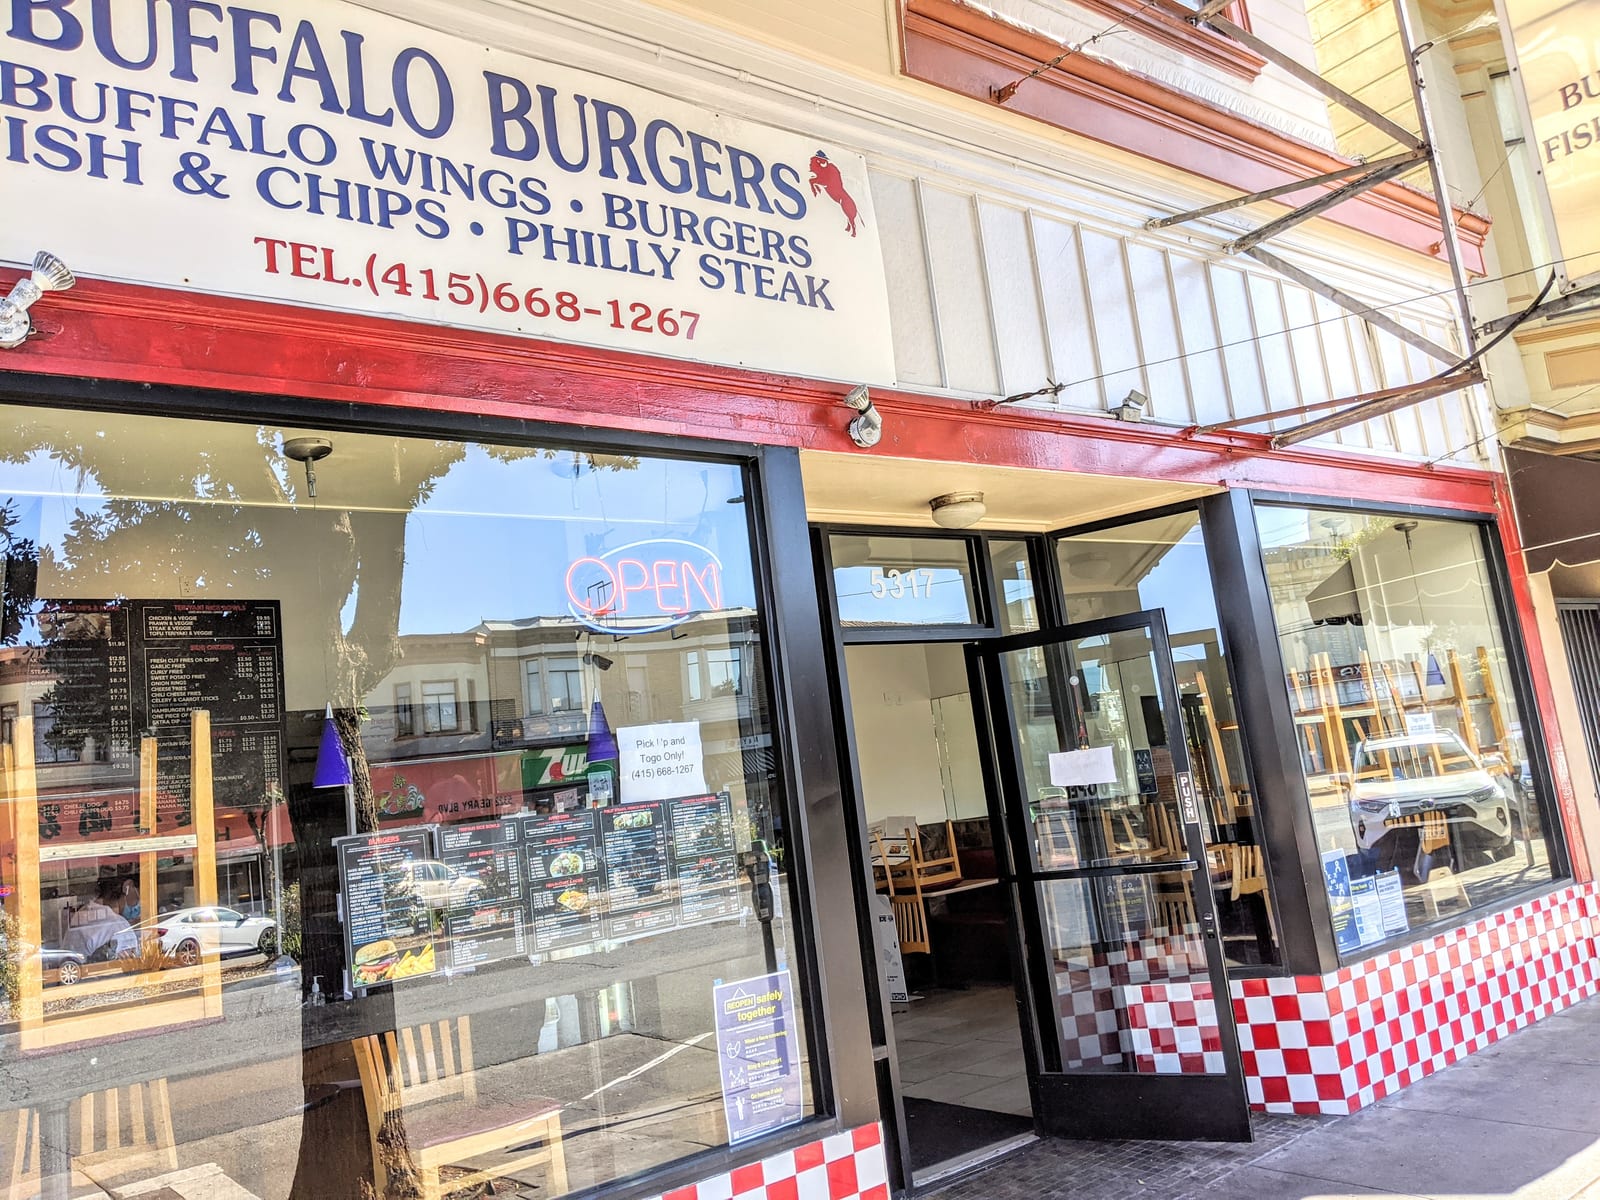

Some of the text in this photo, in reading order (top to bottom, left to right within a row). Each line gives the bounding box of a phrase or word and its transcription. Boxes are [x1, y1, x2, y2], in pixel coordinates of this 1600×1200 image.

[6, 0, 808, 221] BUFFALO BURGERS
[0, 60, 813, 268] BUFFALO WINGS BURGERS
[0, 115, 835, 311] ISH & CHIPS PHILLY STEAK
[565, 558, 722, 613] OPEN
[870, 568, 934, 600] 5317
[636, 739, 655, 750] Pick
[671, 737, 686, 747] and
[640, 751, 685, 766] Togo Only!
[631, 764, 694, 780] (415) 668-1267
[1180, 776, 1194, 819] PUSH
[756, 990, 782, 1004] safely
[737, 1005, 777, 1022] together
